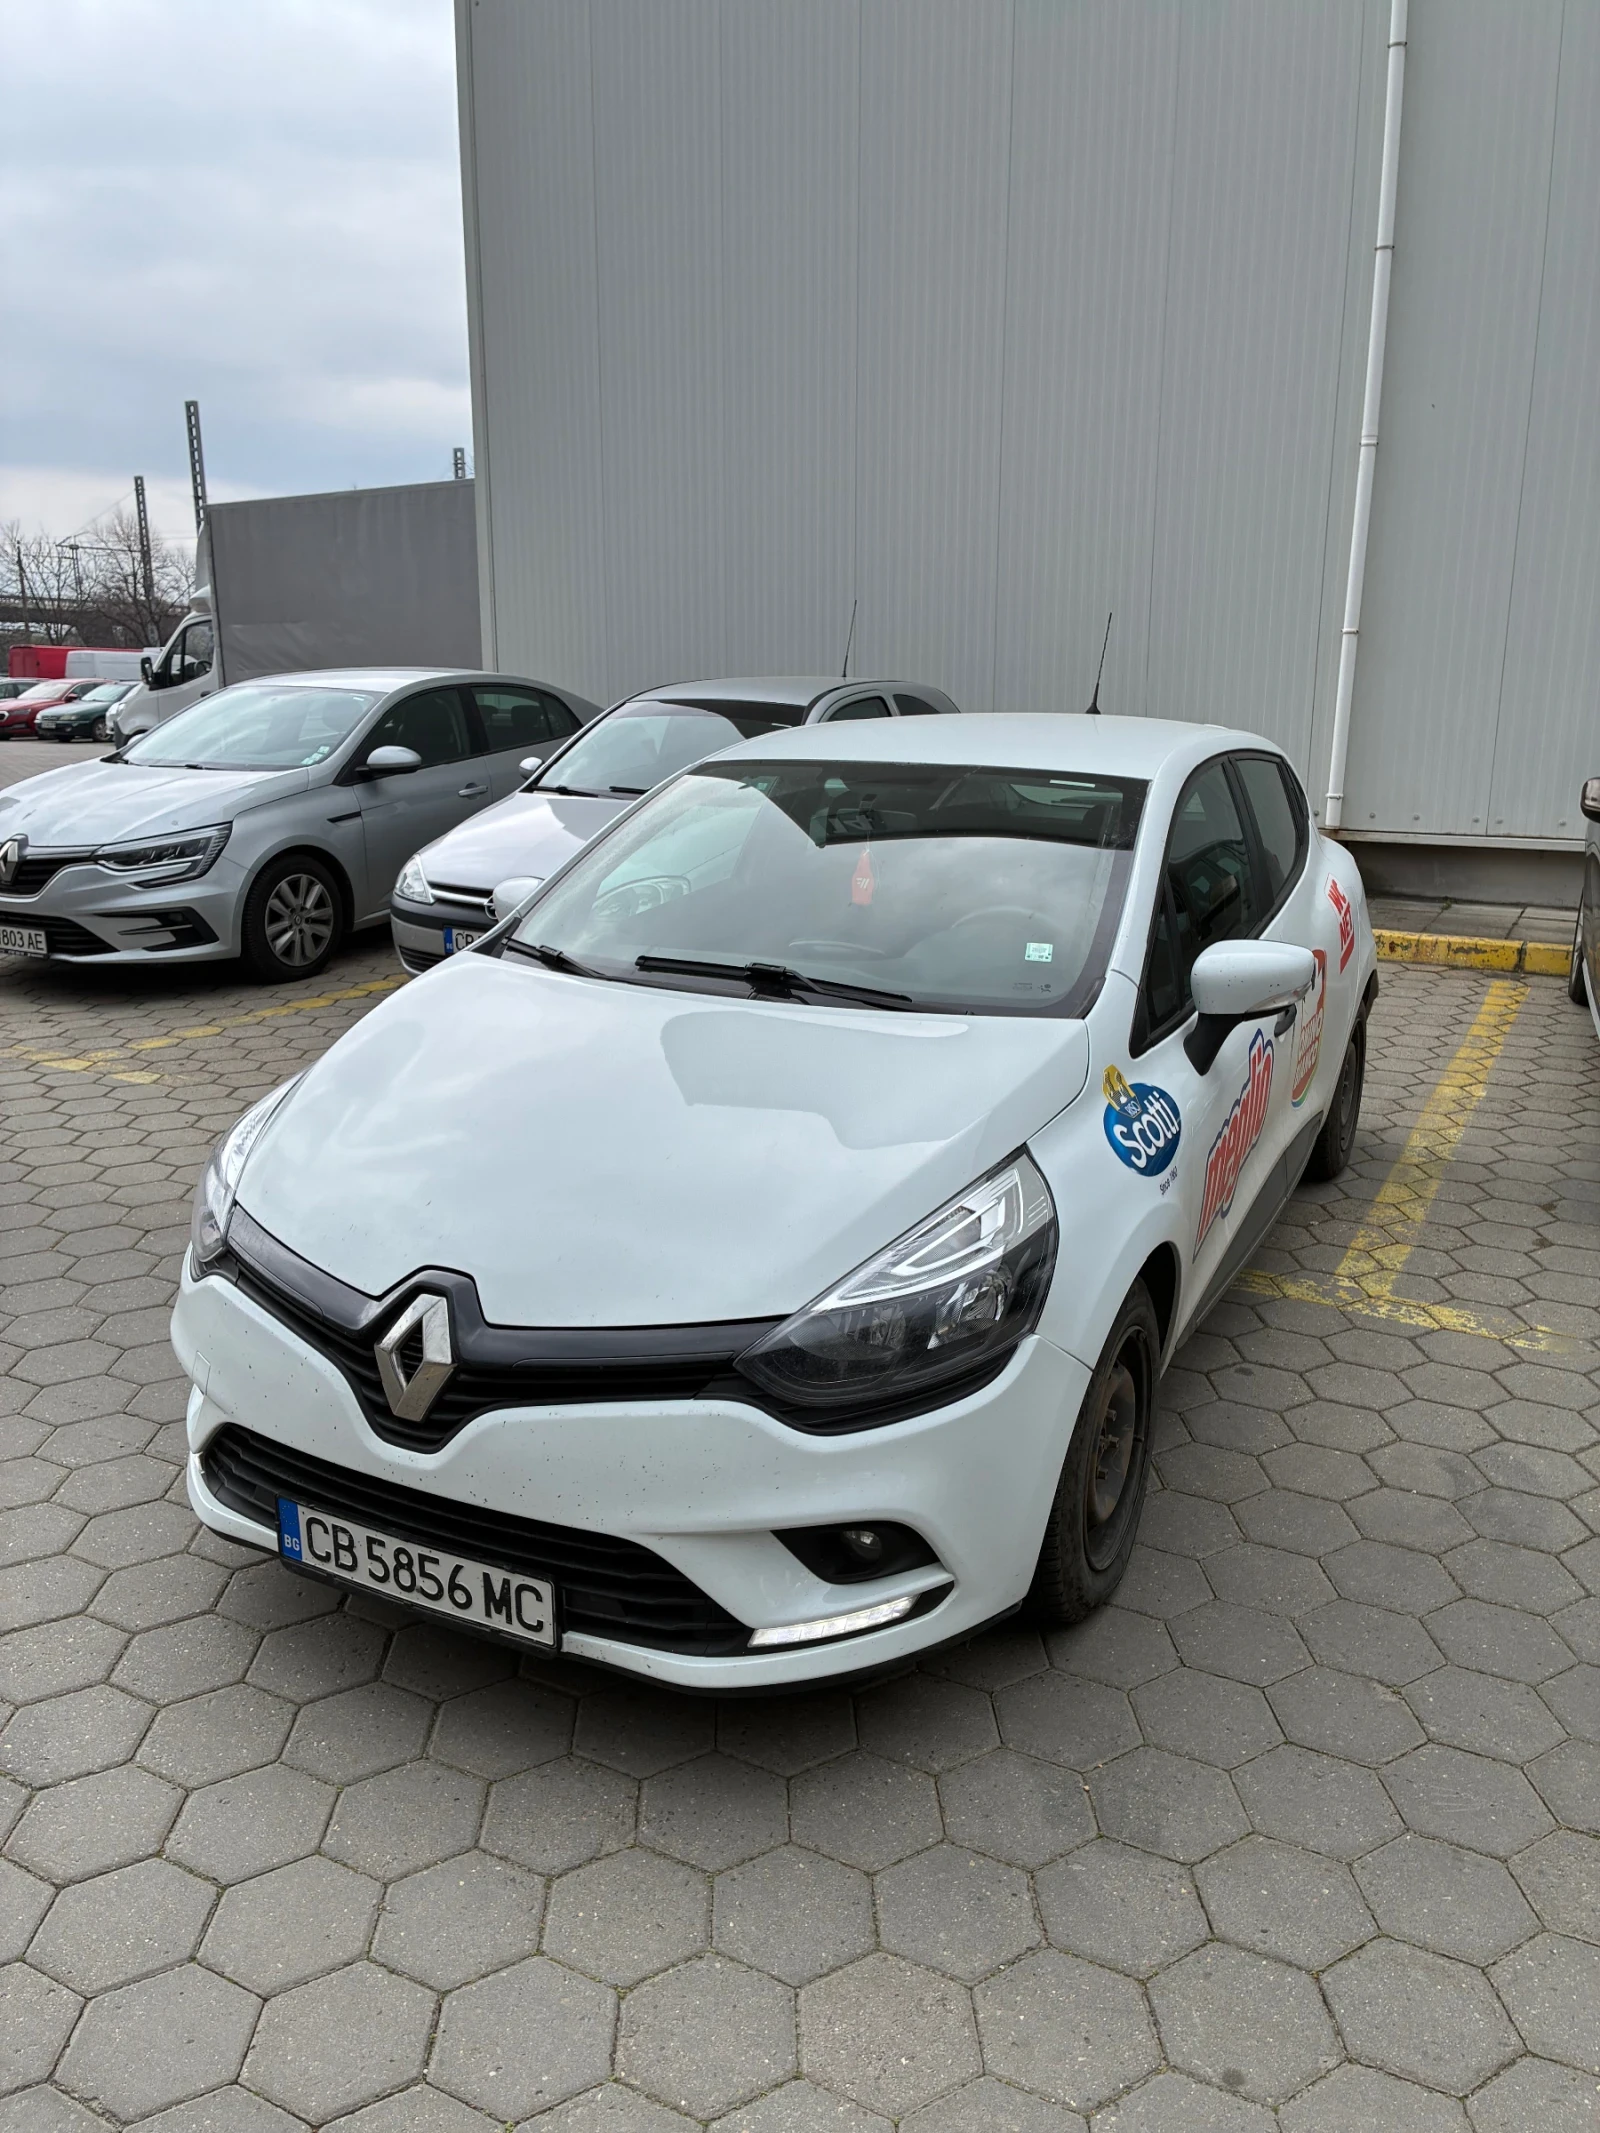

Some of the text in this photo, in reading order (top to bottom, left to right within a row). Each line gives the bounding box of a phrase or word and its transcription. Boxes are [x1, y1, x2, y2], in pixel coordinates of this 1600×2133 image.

[1328, 879, 1347, 916] WC
[0, 929, 44, 950] 803 AE
[1339, 901, 1353, 952] NET
[1113, 1091, 1179, 1168] Scotti
[1196, 1040, 1272, 1247] meglio
[284, 1534, 300, 1551] BG
[305, 1516, 544, 1633] CB 5856 MC
